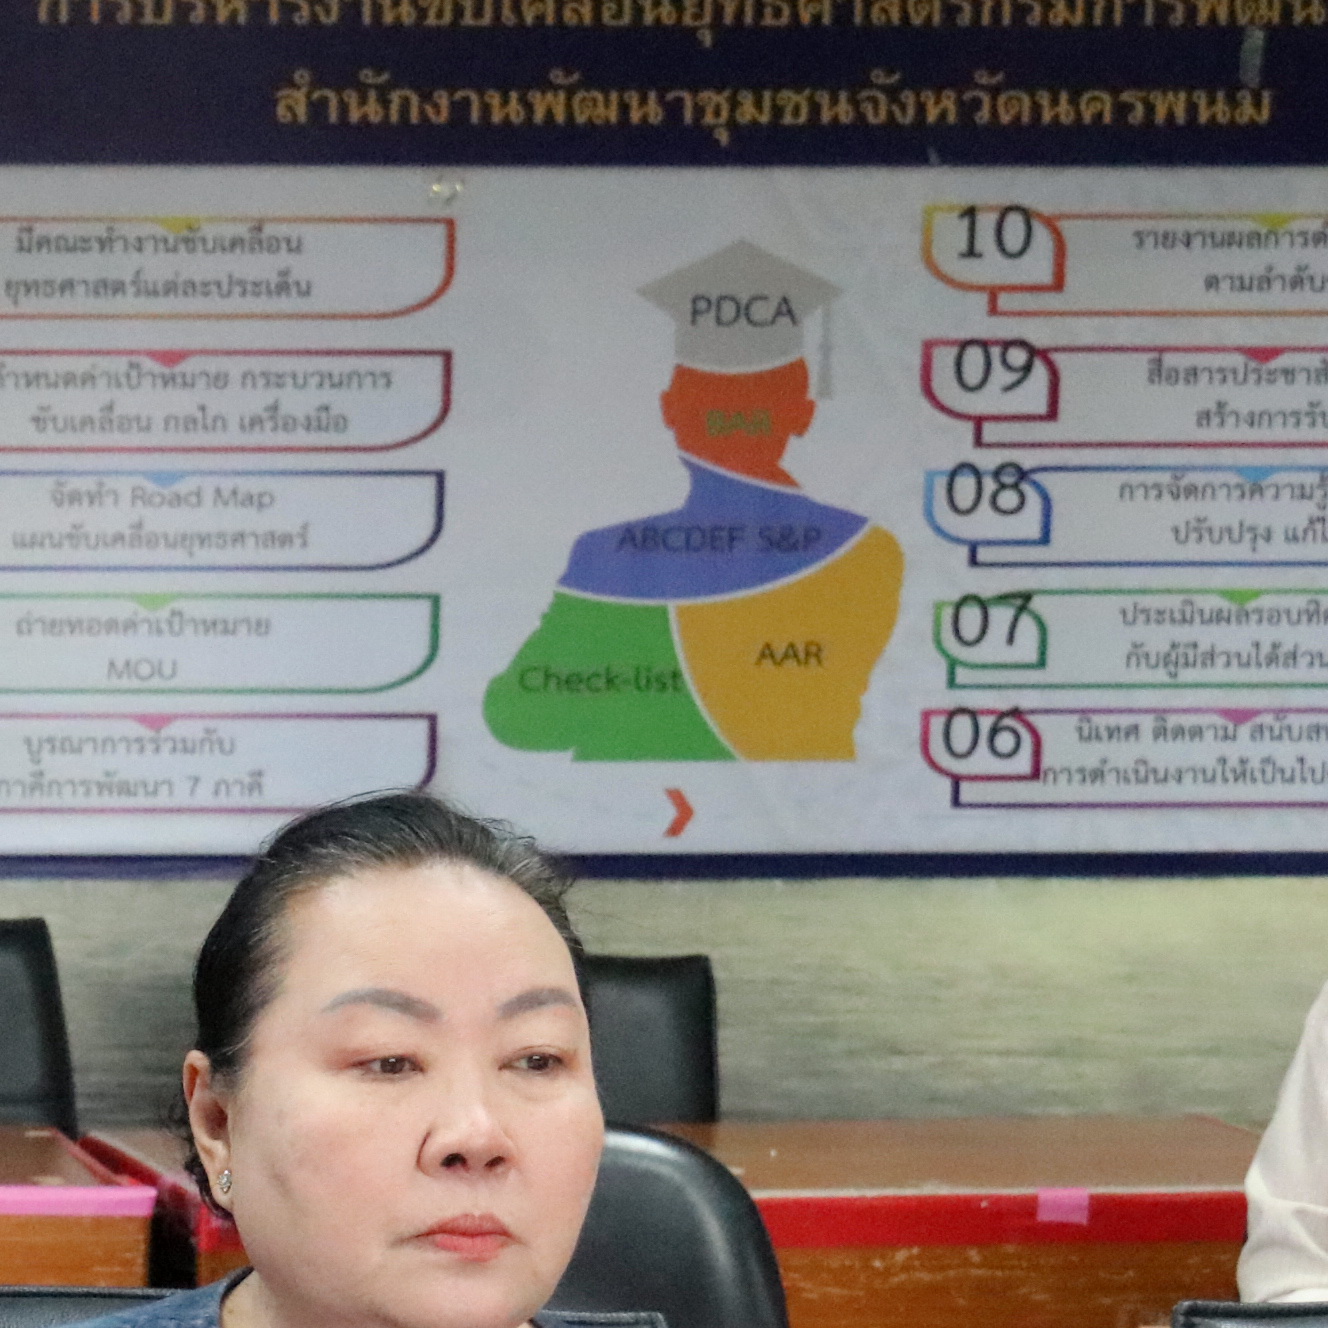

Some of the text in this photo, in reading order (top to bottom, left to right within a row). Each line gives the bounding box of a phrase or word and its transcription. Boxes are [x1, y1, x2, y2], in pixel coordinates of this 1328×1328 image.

[274, 66, 1274, 146] สำนักงานพัฒนาชุมชนจังหวัดนครพนม
[15, 222, 305, 256] มีคณะทำงานขับเคลื่อน
[956, 204, 1034, 261] 10
[3, 270, 313, 307] ยุทธศาสตร์แต่ละประเด็น
[1204, 265, 1328, 293] ตามลำดับ
[690, 294, 798, 330] PDCA
[240, 366, 393, 392] กระบวนการ
[953, 339, 1035, 394] 09
[30, 404, 349, 436] ขับเคลื่อน กลไก เครื่องมือ
[50, 481, 276, 513] จัดทำ Road Map
[945, 461, 1027, 516] 08
[13, 520, 309, 557] แผนขับเคลื่อนยุทธศาสตร์
[617, 525, 822, 554] ABCDEF S&P
[15, 607, 271, 639] ถ่ายทอดค่าเป้าหมาย
[952, 592, 1034, 646] 07
[107, 658, 177, 681] MOU
[754, 642, 825, 668] AAR
[519, 665, 685, 696] Check-list
[24, 727, 236, 766] บูรณาการร่วมกับ
[942, 705, 1023, 761] 06
[186, 776, 200, 798] 7
[213, 772, 264, 799] ภาคี
[1041, 757, 1328, 787] การดำเนินงานให้เป็นไป
